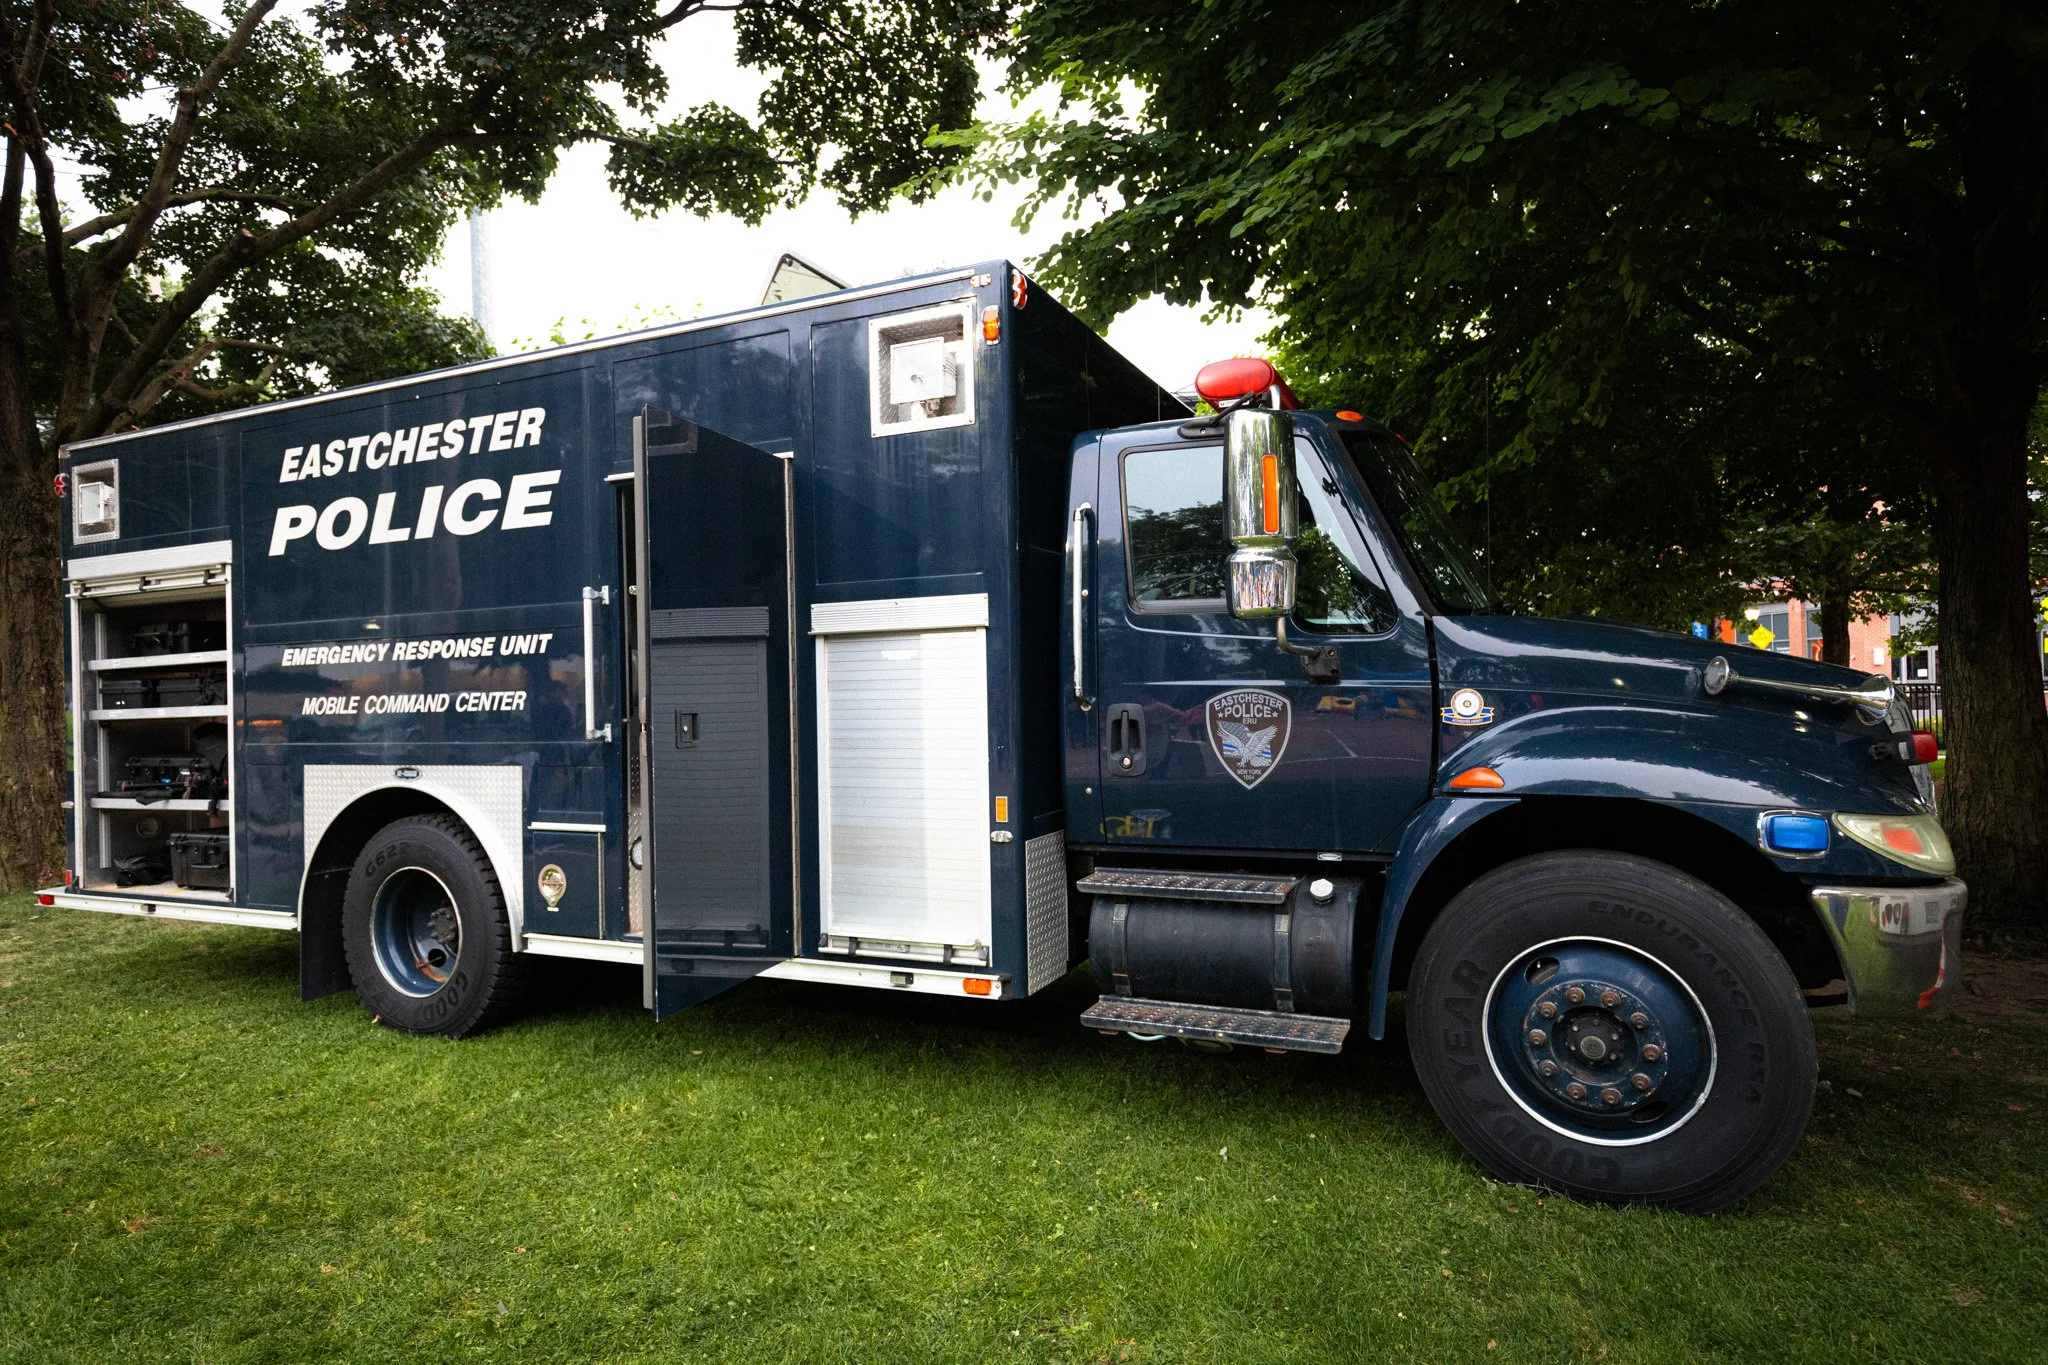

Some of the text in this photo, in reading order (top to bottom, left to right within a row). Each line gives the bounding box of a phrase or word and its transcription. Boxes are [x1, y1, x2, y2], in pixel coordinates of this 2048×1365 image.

[280, 408, 546, 482] EASTCHESTER
[269, 470, 561, 556] POLICE
[282, 634, 552, 666] EMERGENCY RESPONSE UNIT
[302, 691, 526, 715] MOBILE COMMAND CENTER
[1213, 693, 1283, 710] EASTCHESTER
[1225, 703, 1272, 718] POLICE
[1588, 901, 1759, 1027] ENDURANCE
